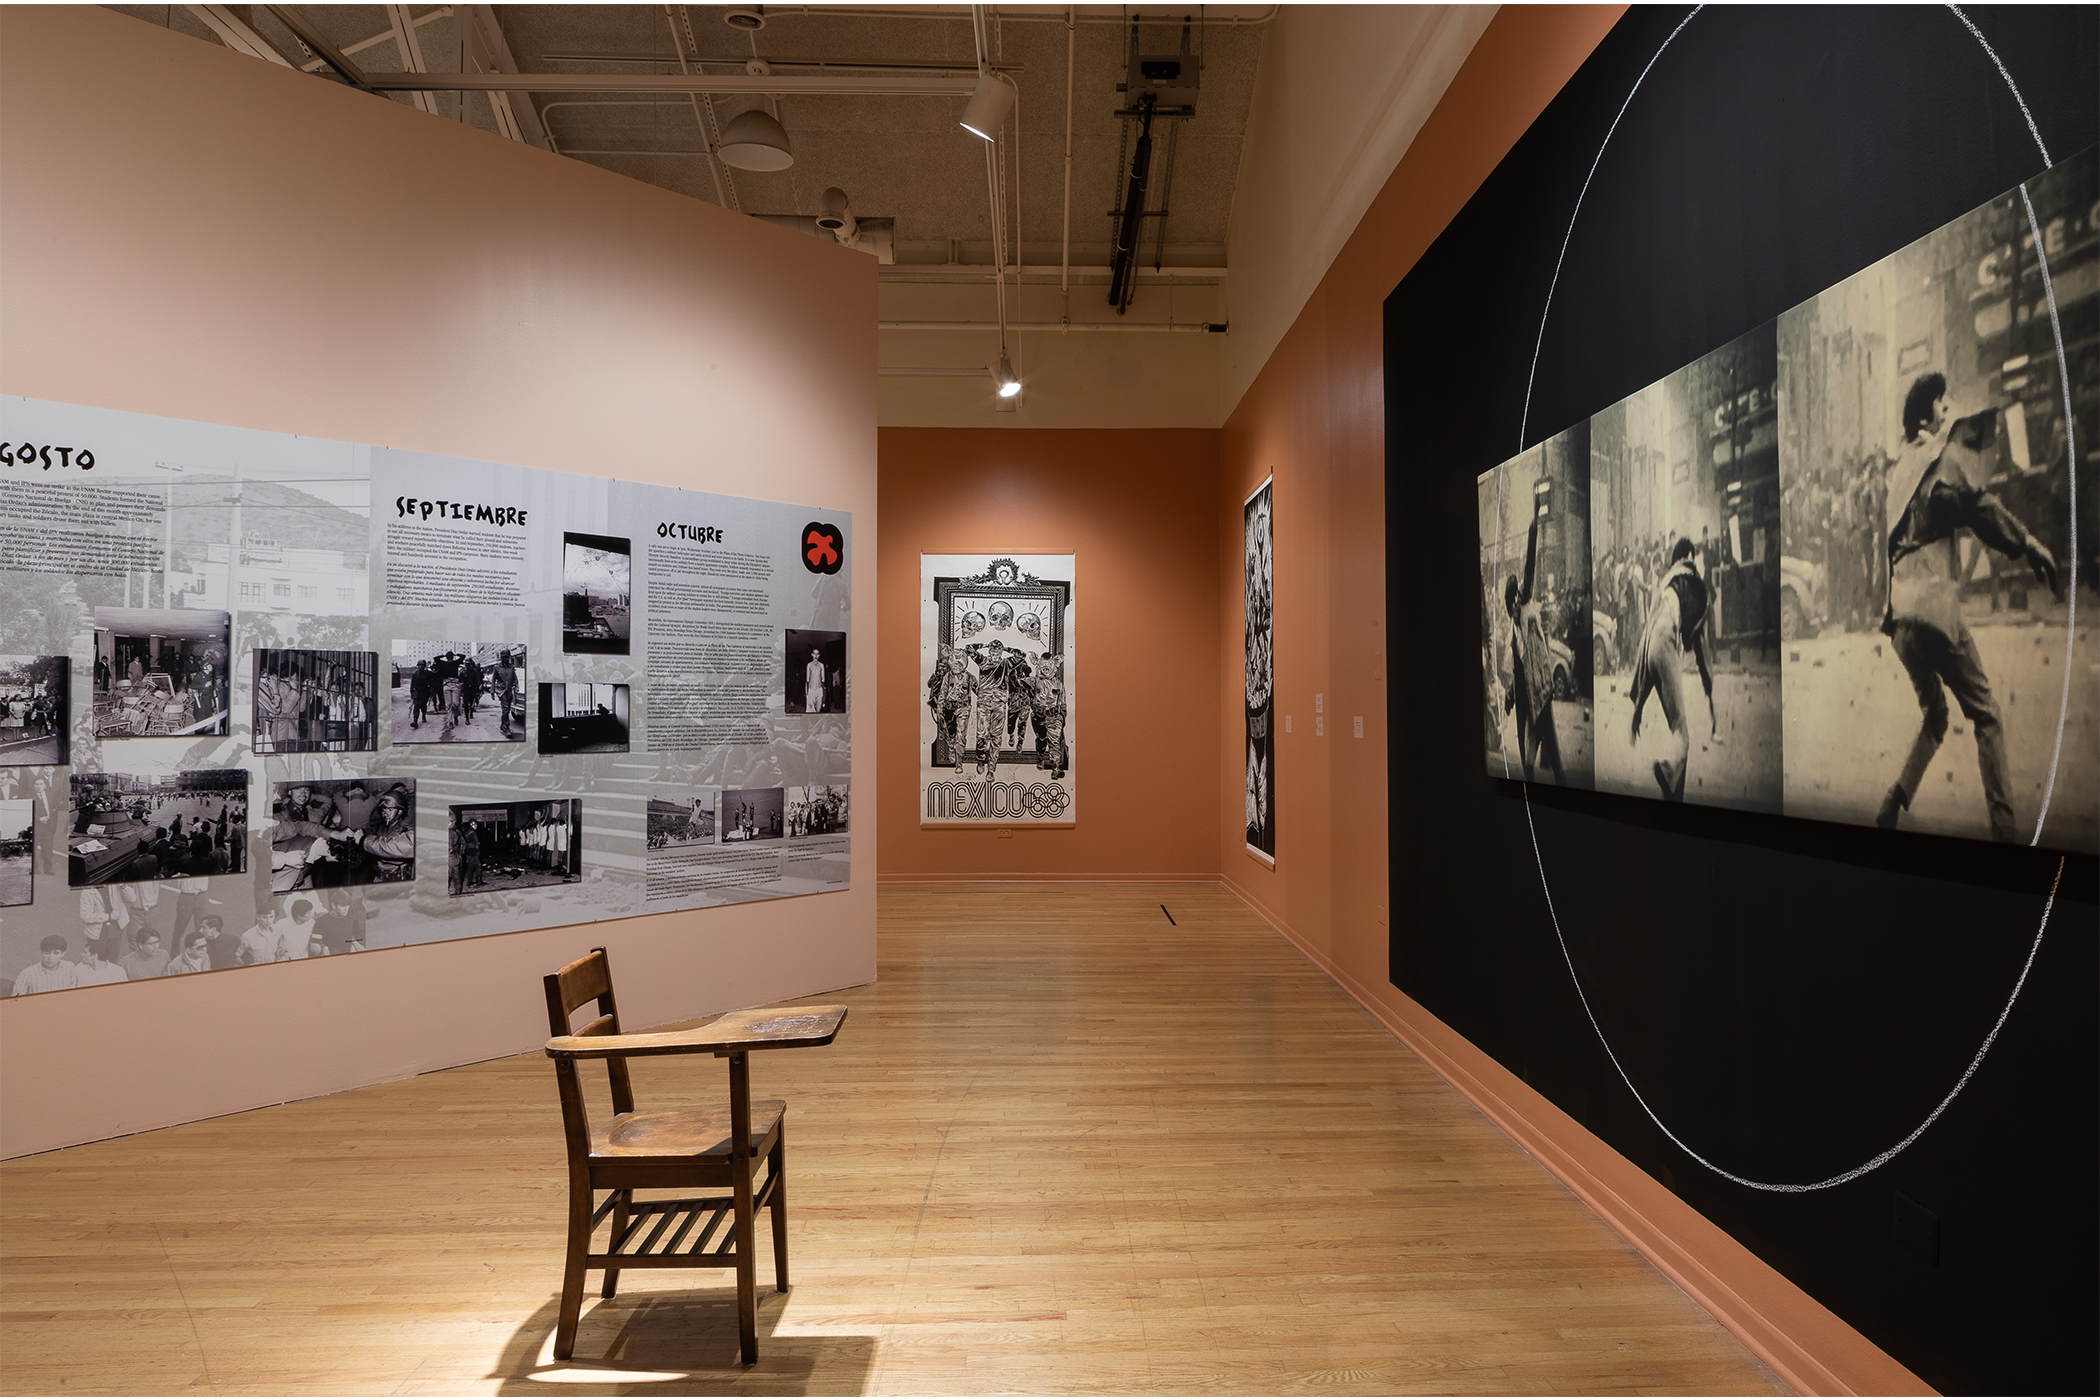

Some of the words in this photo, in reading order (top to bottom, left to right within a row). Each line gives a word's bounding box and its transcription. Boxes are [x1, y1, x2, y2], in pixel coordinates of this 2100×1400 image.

[0, 442, 96, 471] GOSTO
[396, 496, 528, 527] SEPTIEMBRE
[657, 522, 724, 544] OCTUBRE
